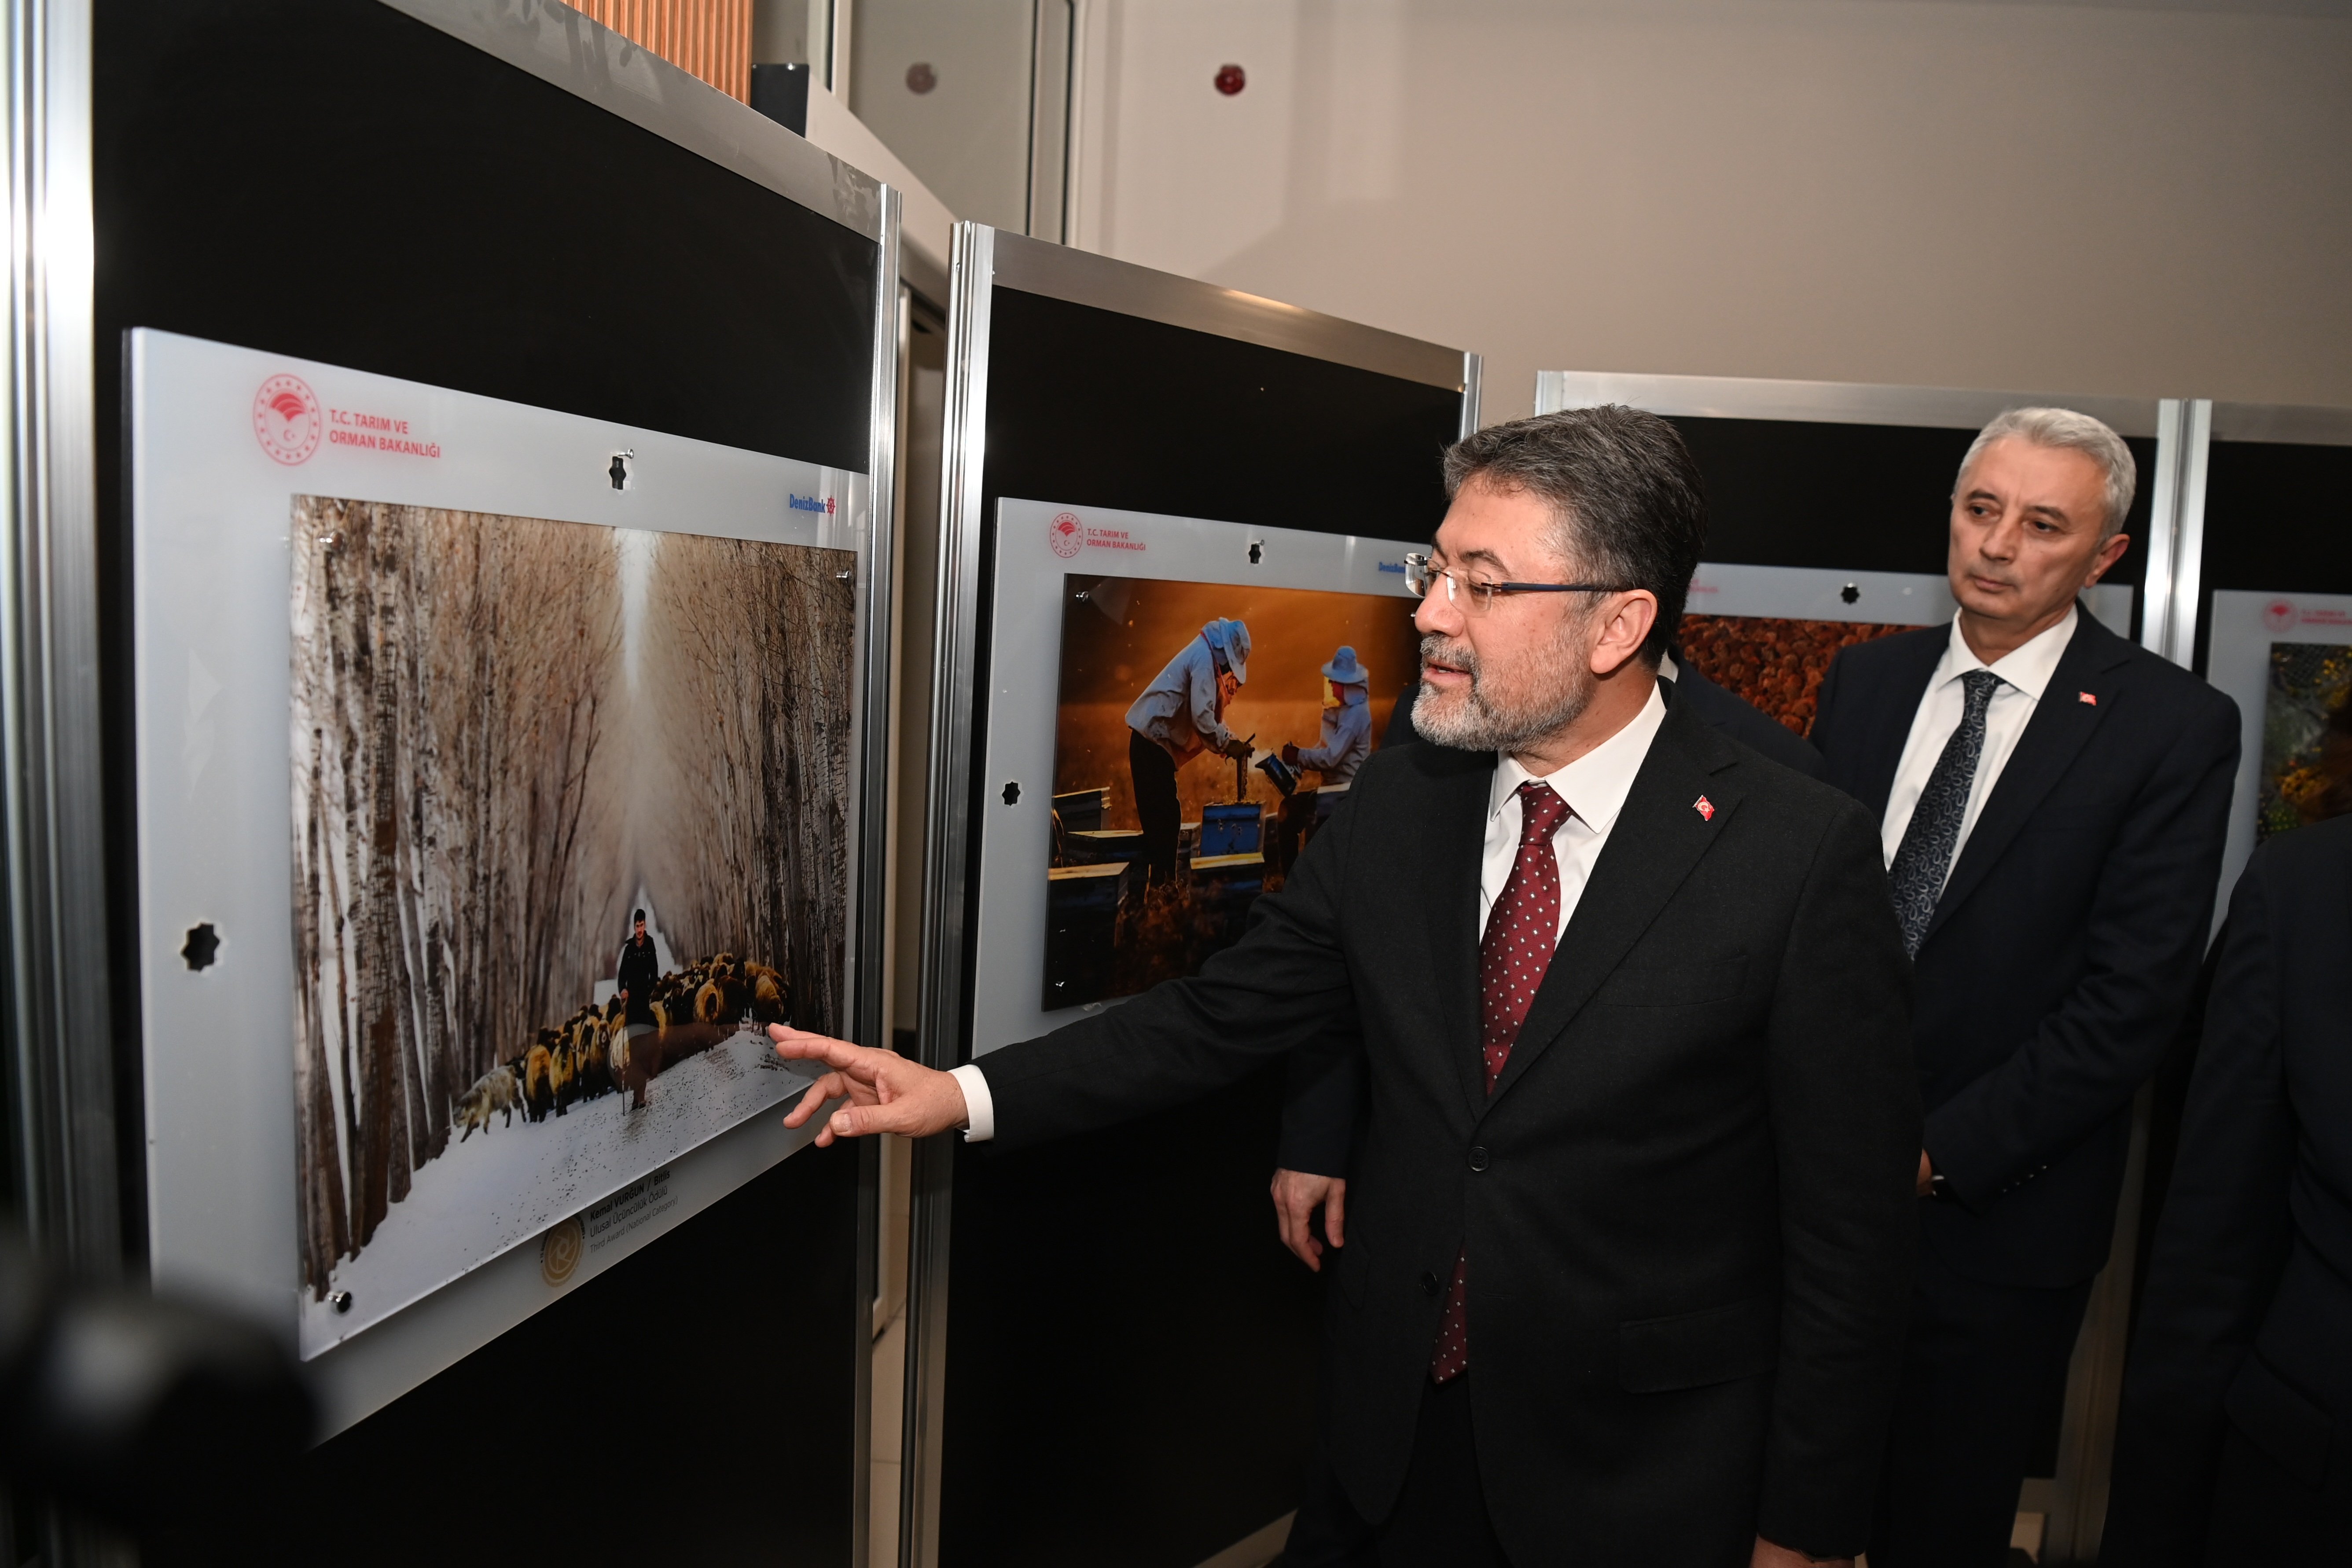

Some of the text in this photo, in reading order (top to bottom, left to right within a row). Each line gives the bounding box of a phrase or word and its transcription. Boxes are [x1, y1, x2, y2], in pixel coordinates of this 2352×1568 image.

[330, 410, 408, 434] T.C. TARIM VE
[329, 430, 441, 458] ORMAN BAKANLIĞI
[789, 493, 826, 513] DenizBank
[1087, 539, 1146, 551] ORMAN BAKANLIĞI
[1100, 529, 1119, 539] TARIM
[590, 1201, 612, 1222] Kemal
[654, 1170, 670, 1186] Bitlis
[590, 1217, 611, 1238] Ulusal
[613, 1197, 647, 1225] Üçüncülük
[649, 1186, 668, 1204] Ödülü
[590, 1195, 678, 1253] Third Award (National Category)
